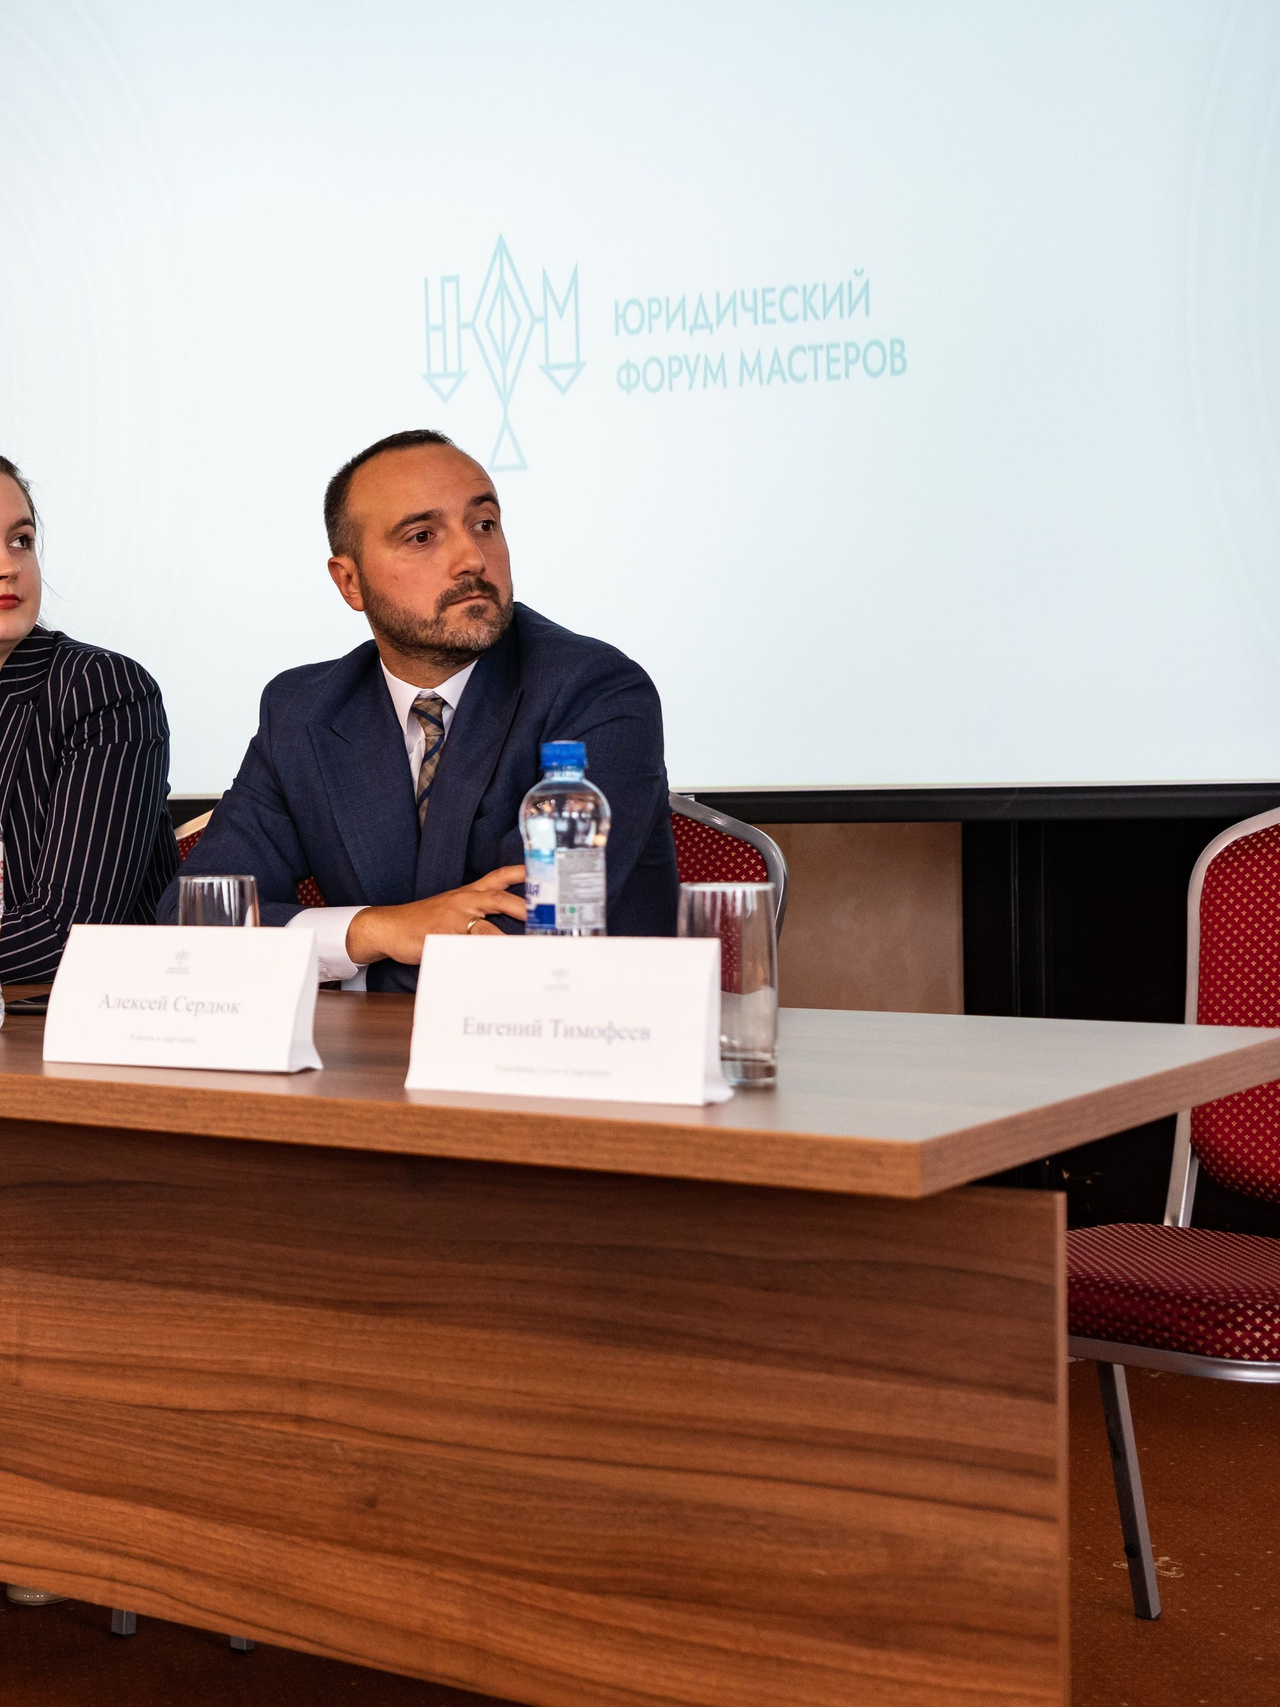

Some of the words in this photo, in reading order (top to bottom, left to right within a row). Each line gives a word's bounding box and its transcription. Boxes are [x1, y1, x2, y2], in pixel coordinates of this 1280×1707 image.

[613, 267, 871, 337] ЮРИДИЧЕСКИЙ
[616, 350, 728, 395] ФОРУМ
[738, 337, 908, 388] МАСТЕРОВ
[98, 993, 168, 1012] Алексей
[173, 995, 241, 1017] Сердюк
[462, 1016, 543, 1038] Евгений
[549, 1018, 652, 1045] Тимофеев
